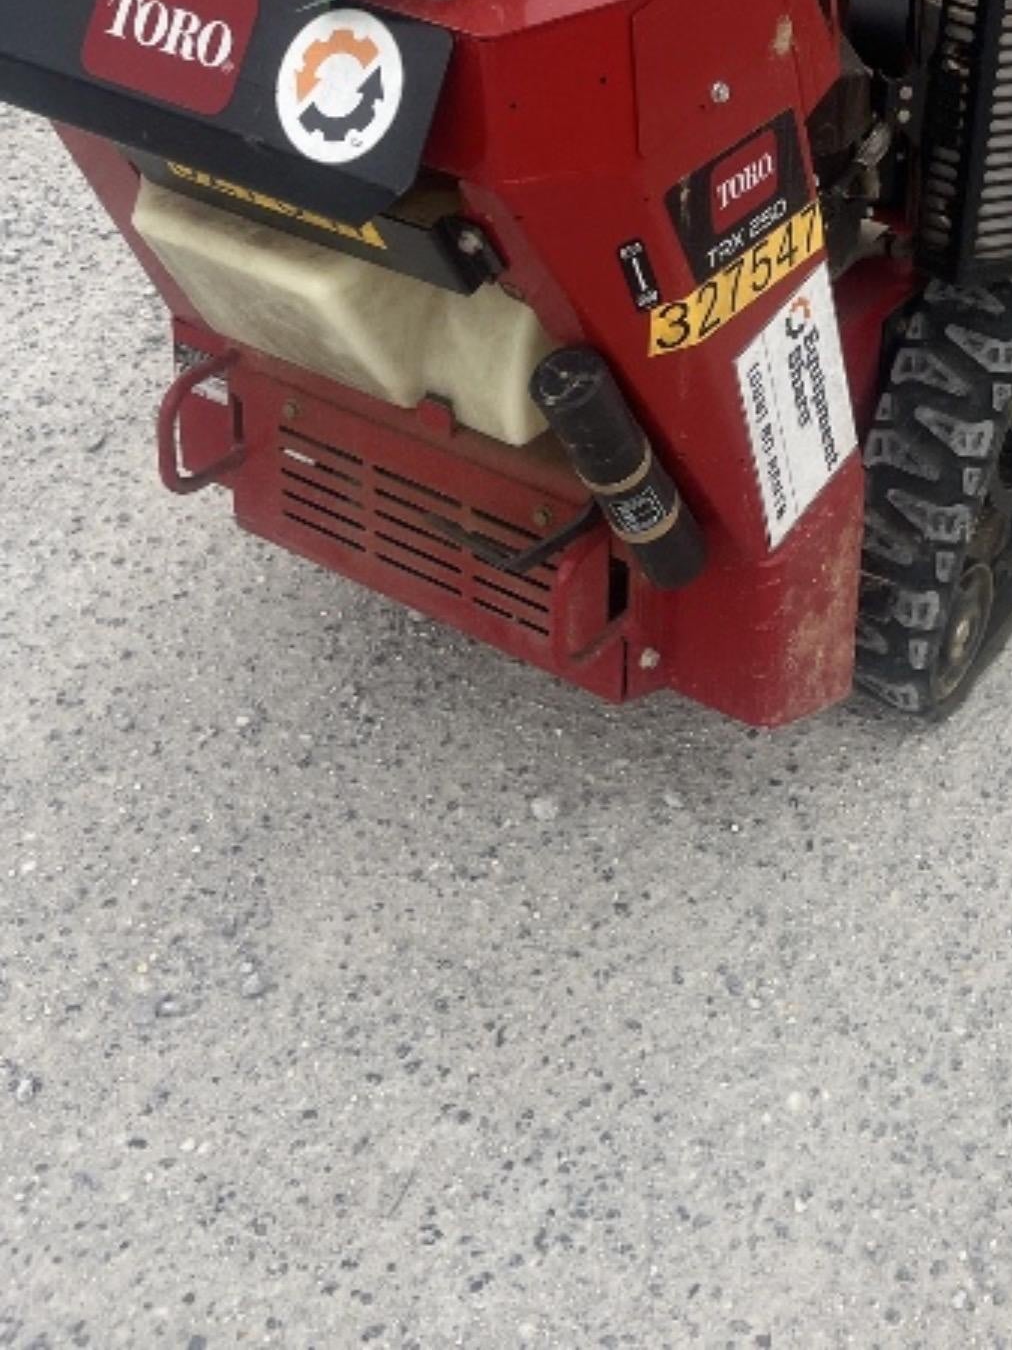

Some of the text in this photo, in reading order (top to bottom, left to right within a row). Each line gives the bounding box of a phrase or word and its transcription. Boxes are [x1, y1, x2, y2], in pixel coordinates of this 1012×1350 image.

[716, 152, 773, 210] TORO
[707, 197, 787, 268] TRX 250
[656, 202, 817, 348] 327547
